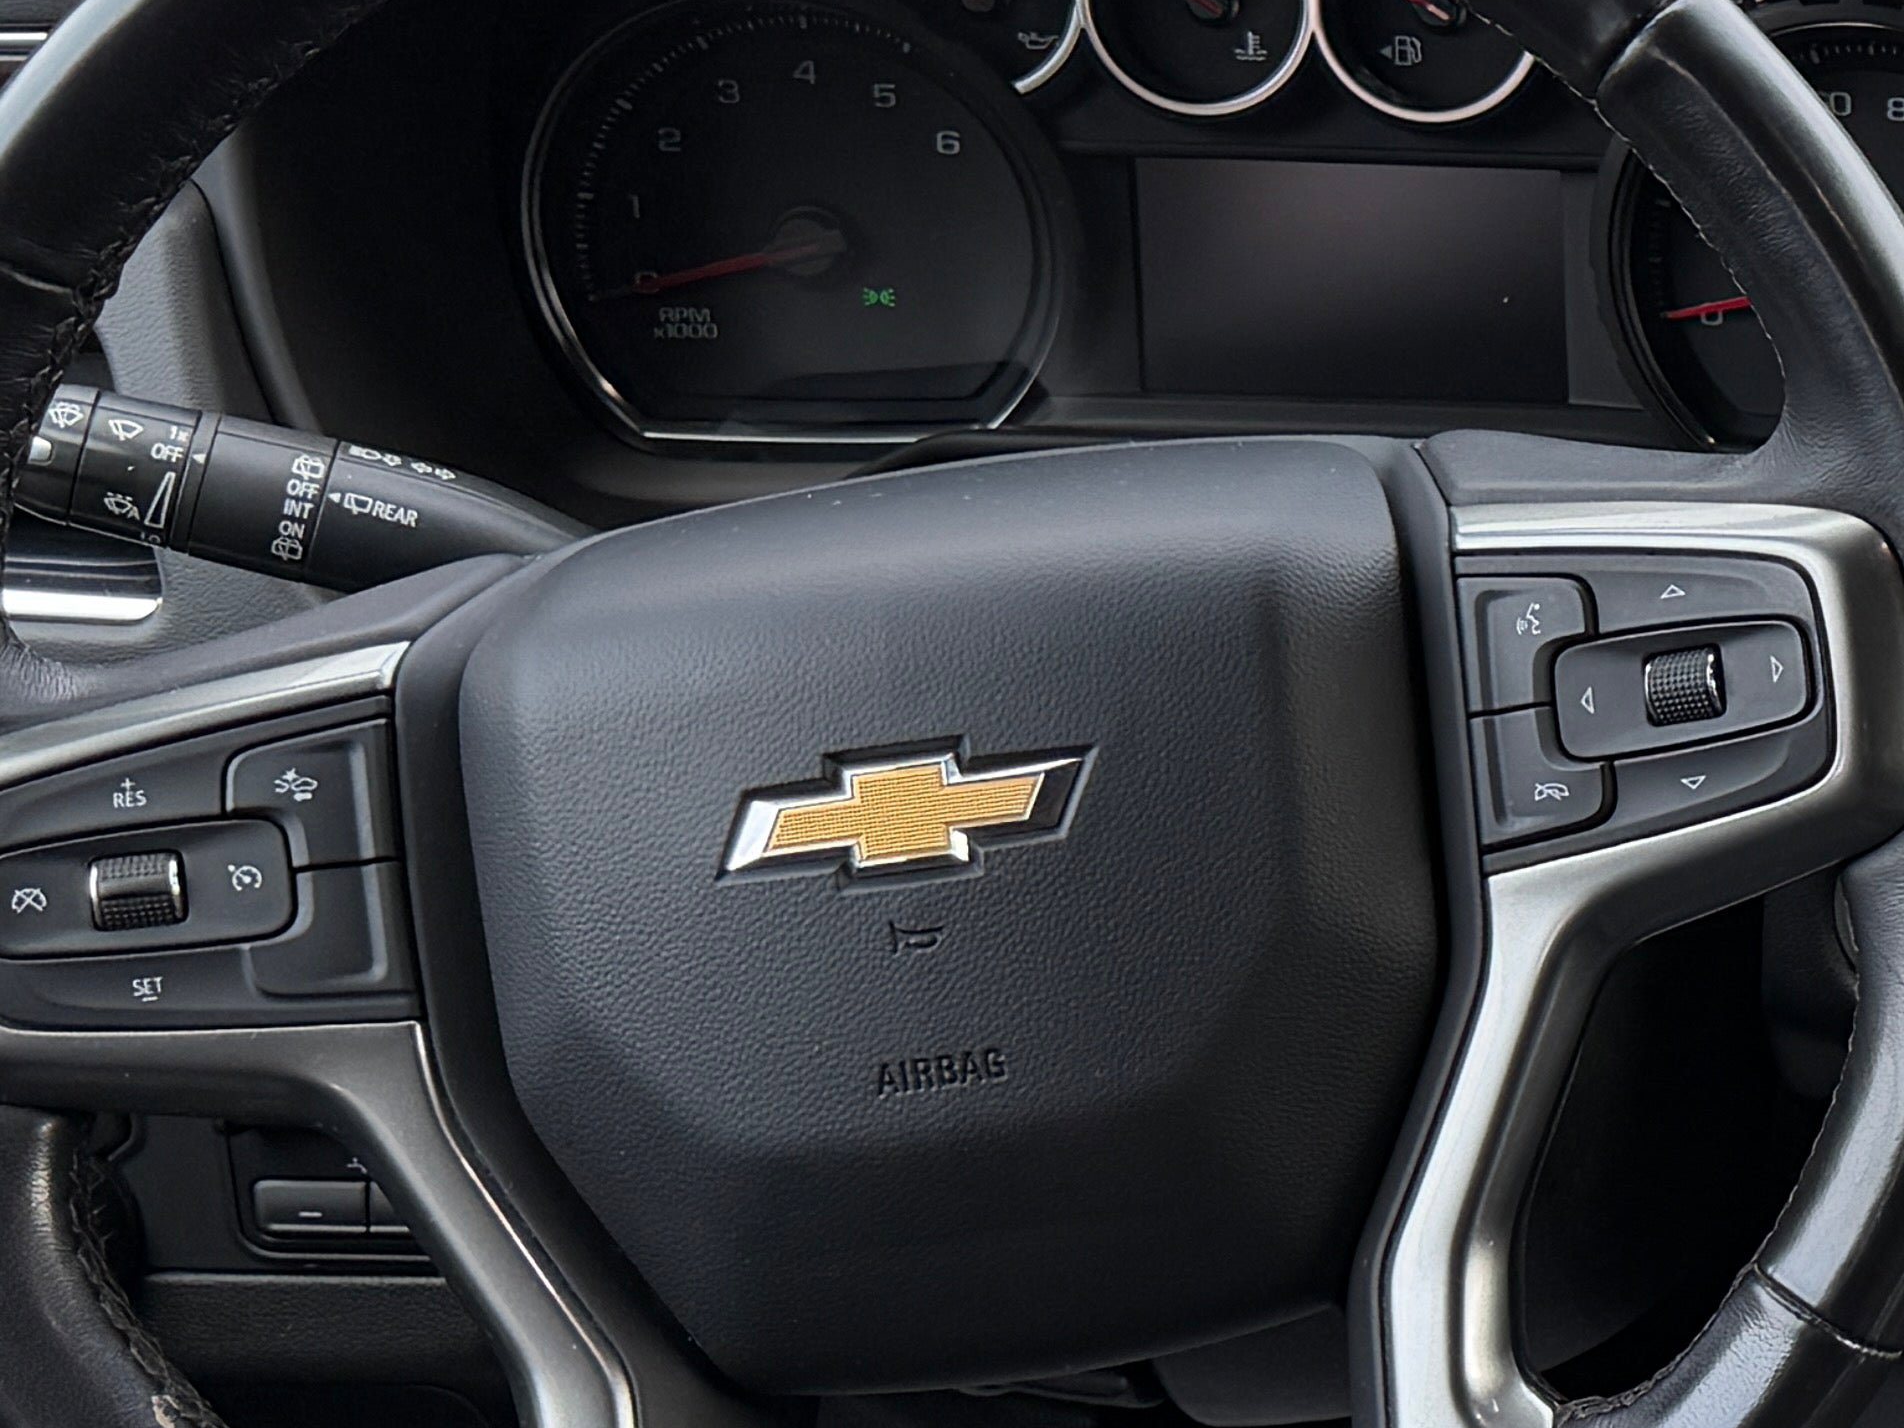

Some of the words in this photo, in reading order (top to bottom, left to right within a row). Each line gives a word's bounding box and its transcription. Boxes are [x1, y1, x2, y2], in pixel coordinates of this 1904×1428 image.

[791, 59, 817, 85] 4
[717, 79, 741, 105] 3
[872, 83, 898, 109] 5
[656, 125, 683, 153] 2
[935, 129, 961, 155] 6
[627, 194, 641, 220] 1
[658, 305, 711, 325] RPM
[654, 322, 719, 340] x1000
[150, 443, 183, 464] OFF
[286, 479, 321, 499] OFF
[283, 498, 314, 519] INT
[371, 501, 419, 528] REAR
[278, 520, 306, 539] ON
[112, 789, 148, 808] RES
[132, 976, 163, 996] SET
[877, 1047, 1007, 1099] AIRBAG
